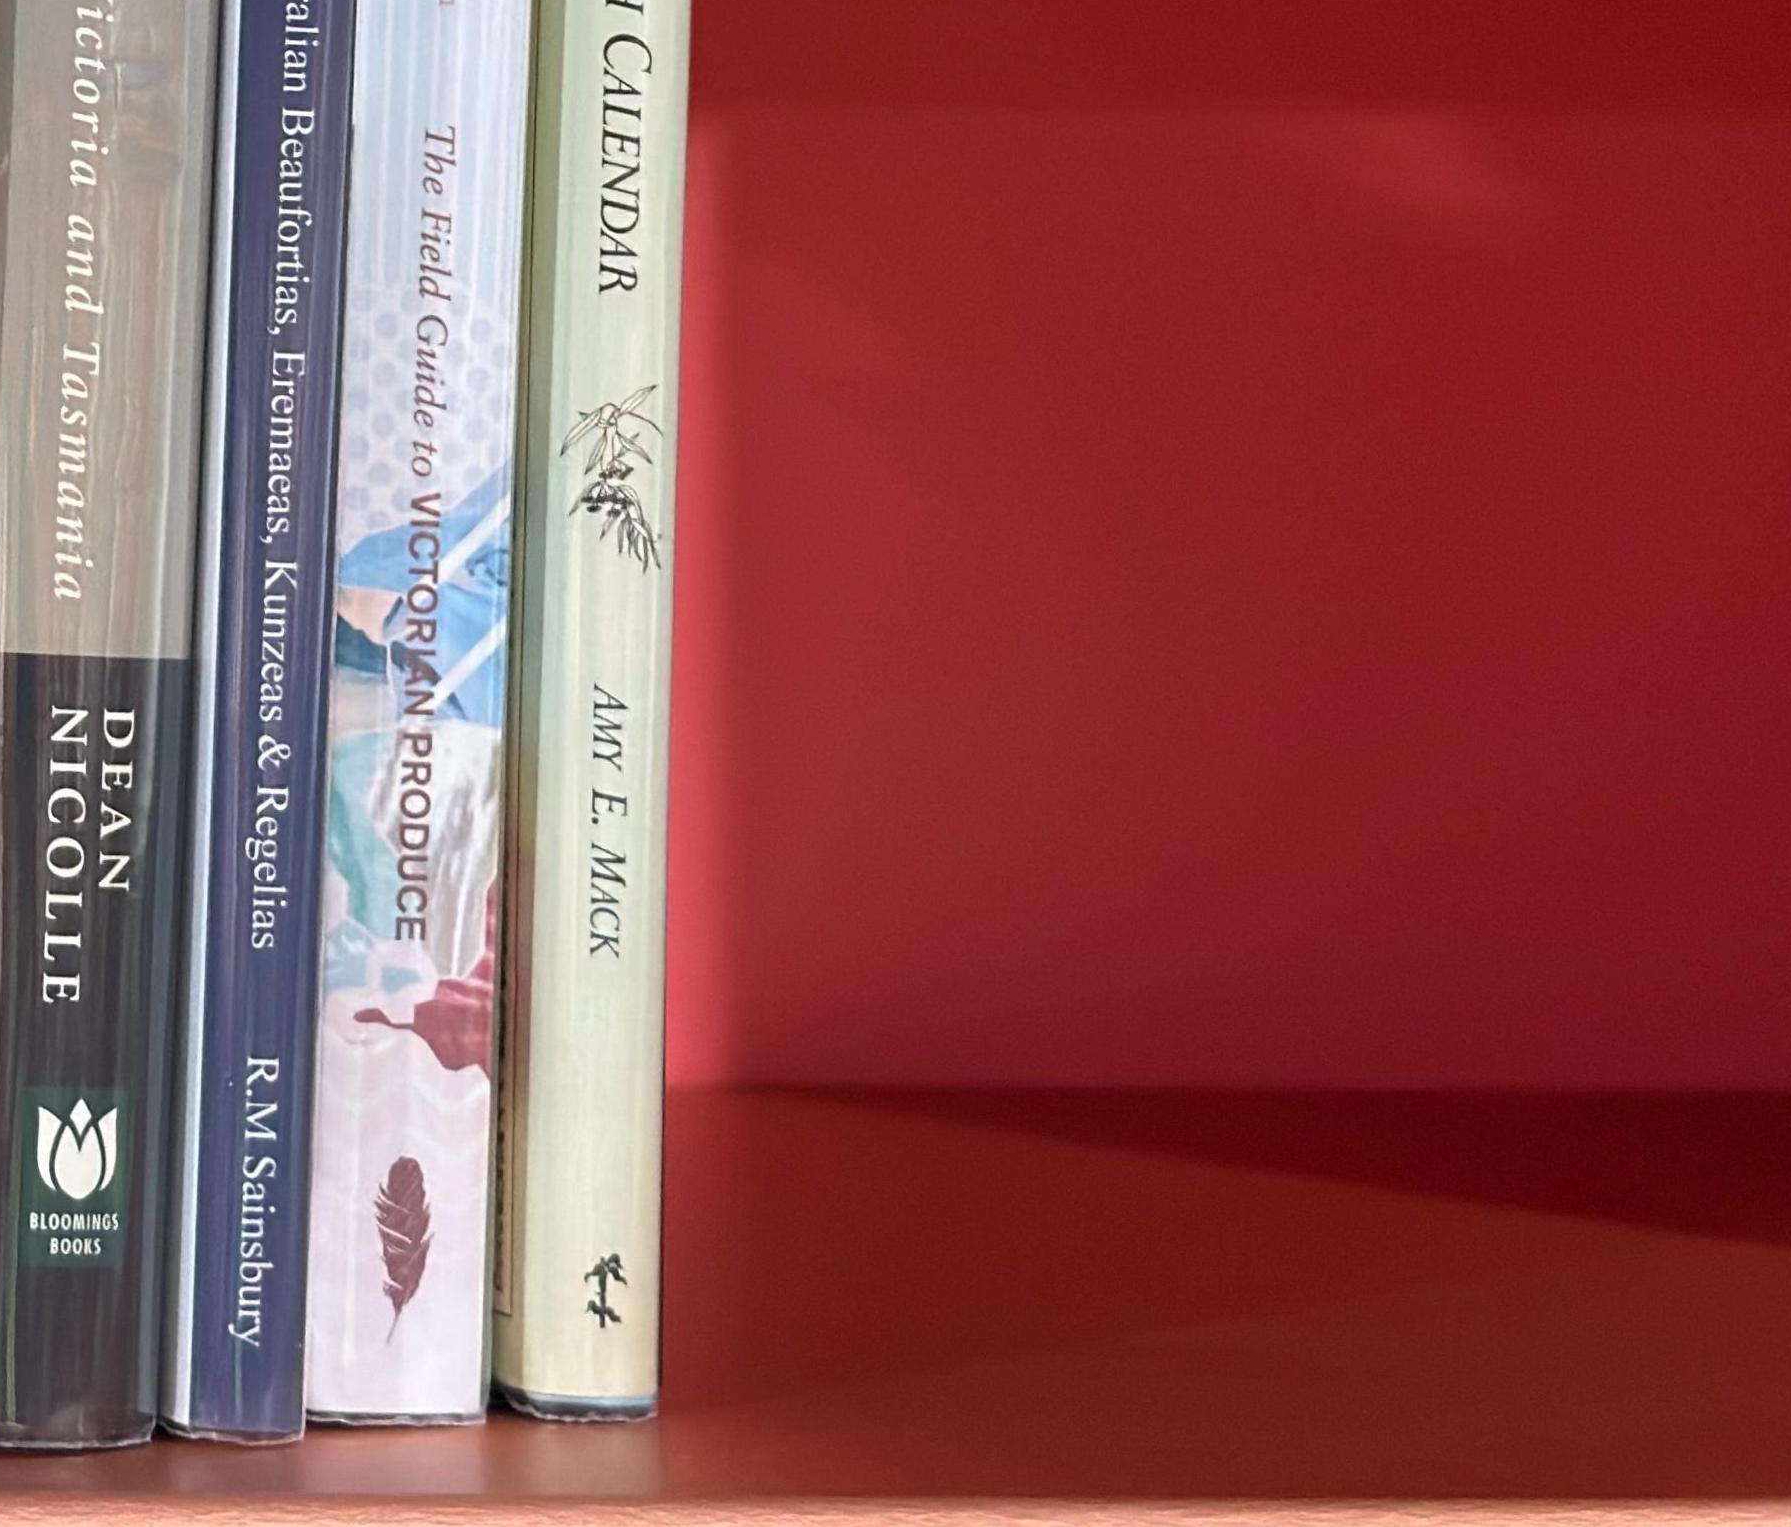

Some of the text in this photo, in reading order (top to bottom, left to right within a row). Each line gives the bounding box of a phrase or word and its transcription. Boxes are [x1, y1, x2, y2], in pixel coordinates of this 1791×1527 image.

[267, 106, 315, 335] Beaufortias,
[597, 33, 652, 294] CALENDAR
[62, 215, 104, 317] and
[53, 340, 100, 601] Tasmania
[259, 350, 306, 545] Eremaeas,
[395, 125, 458, 942] The Field Guide to VICTORIAN PRODUCE
[259, 559, 299, 724] Kunzeas
[98, 708, 134, 894] DEAN
[257, 735, 291, 768] &
[589, 683, 632, 957] AMY E. MACK
[43, 704, 88, 1005] NICOLLE
[246, 784, 289, 951] Regelias
[30, 1212, 119, 1231] BLOOMINGS
[49, 1236, 103, 1256] BOOKS
